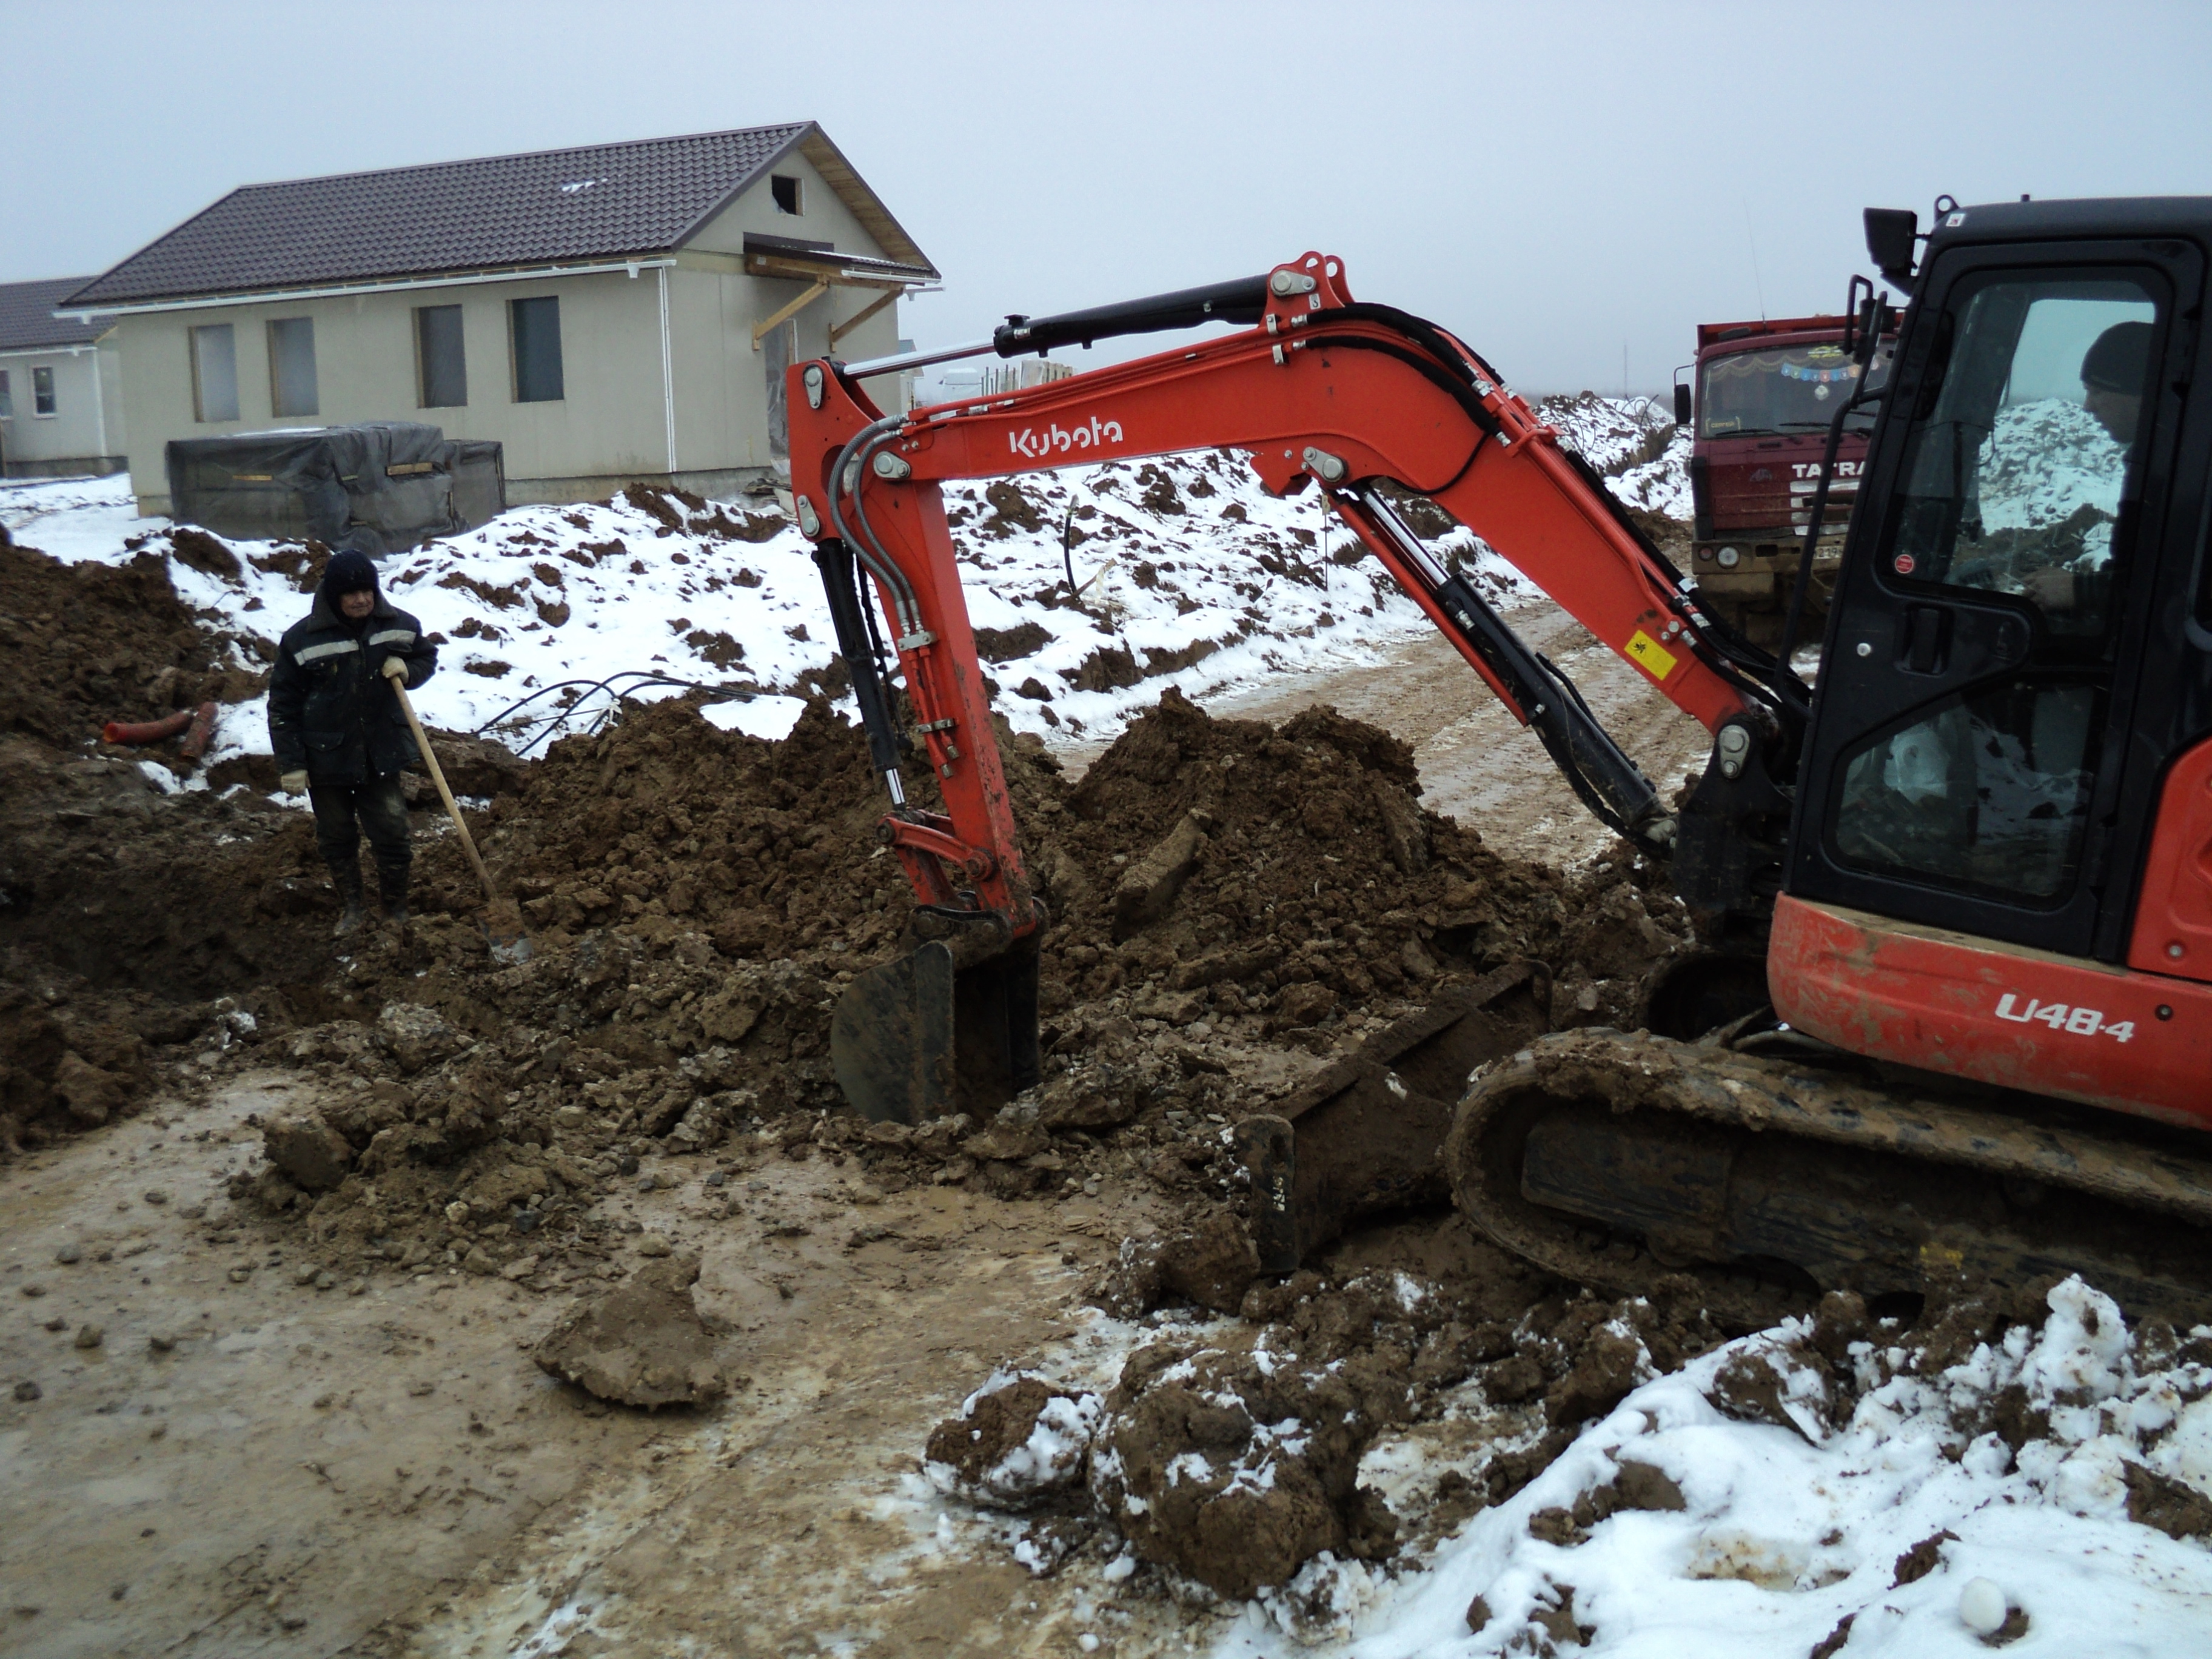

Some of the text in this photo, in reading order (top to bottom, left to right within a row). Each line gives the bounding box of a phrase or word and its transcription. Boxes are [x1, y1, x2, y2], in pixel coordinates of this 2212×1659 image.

[1009, 416, 1124, 458] Kubota
[1791, 461, 1866, 478] TAR
[1995, 993, 2135, 1043] U48-4
